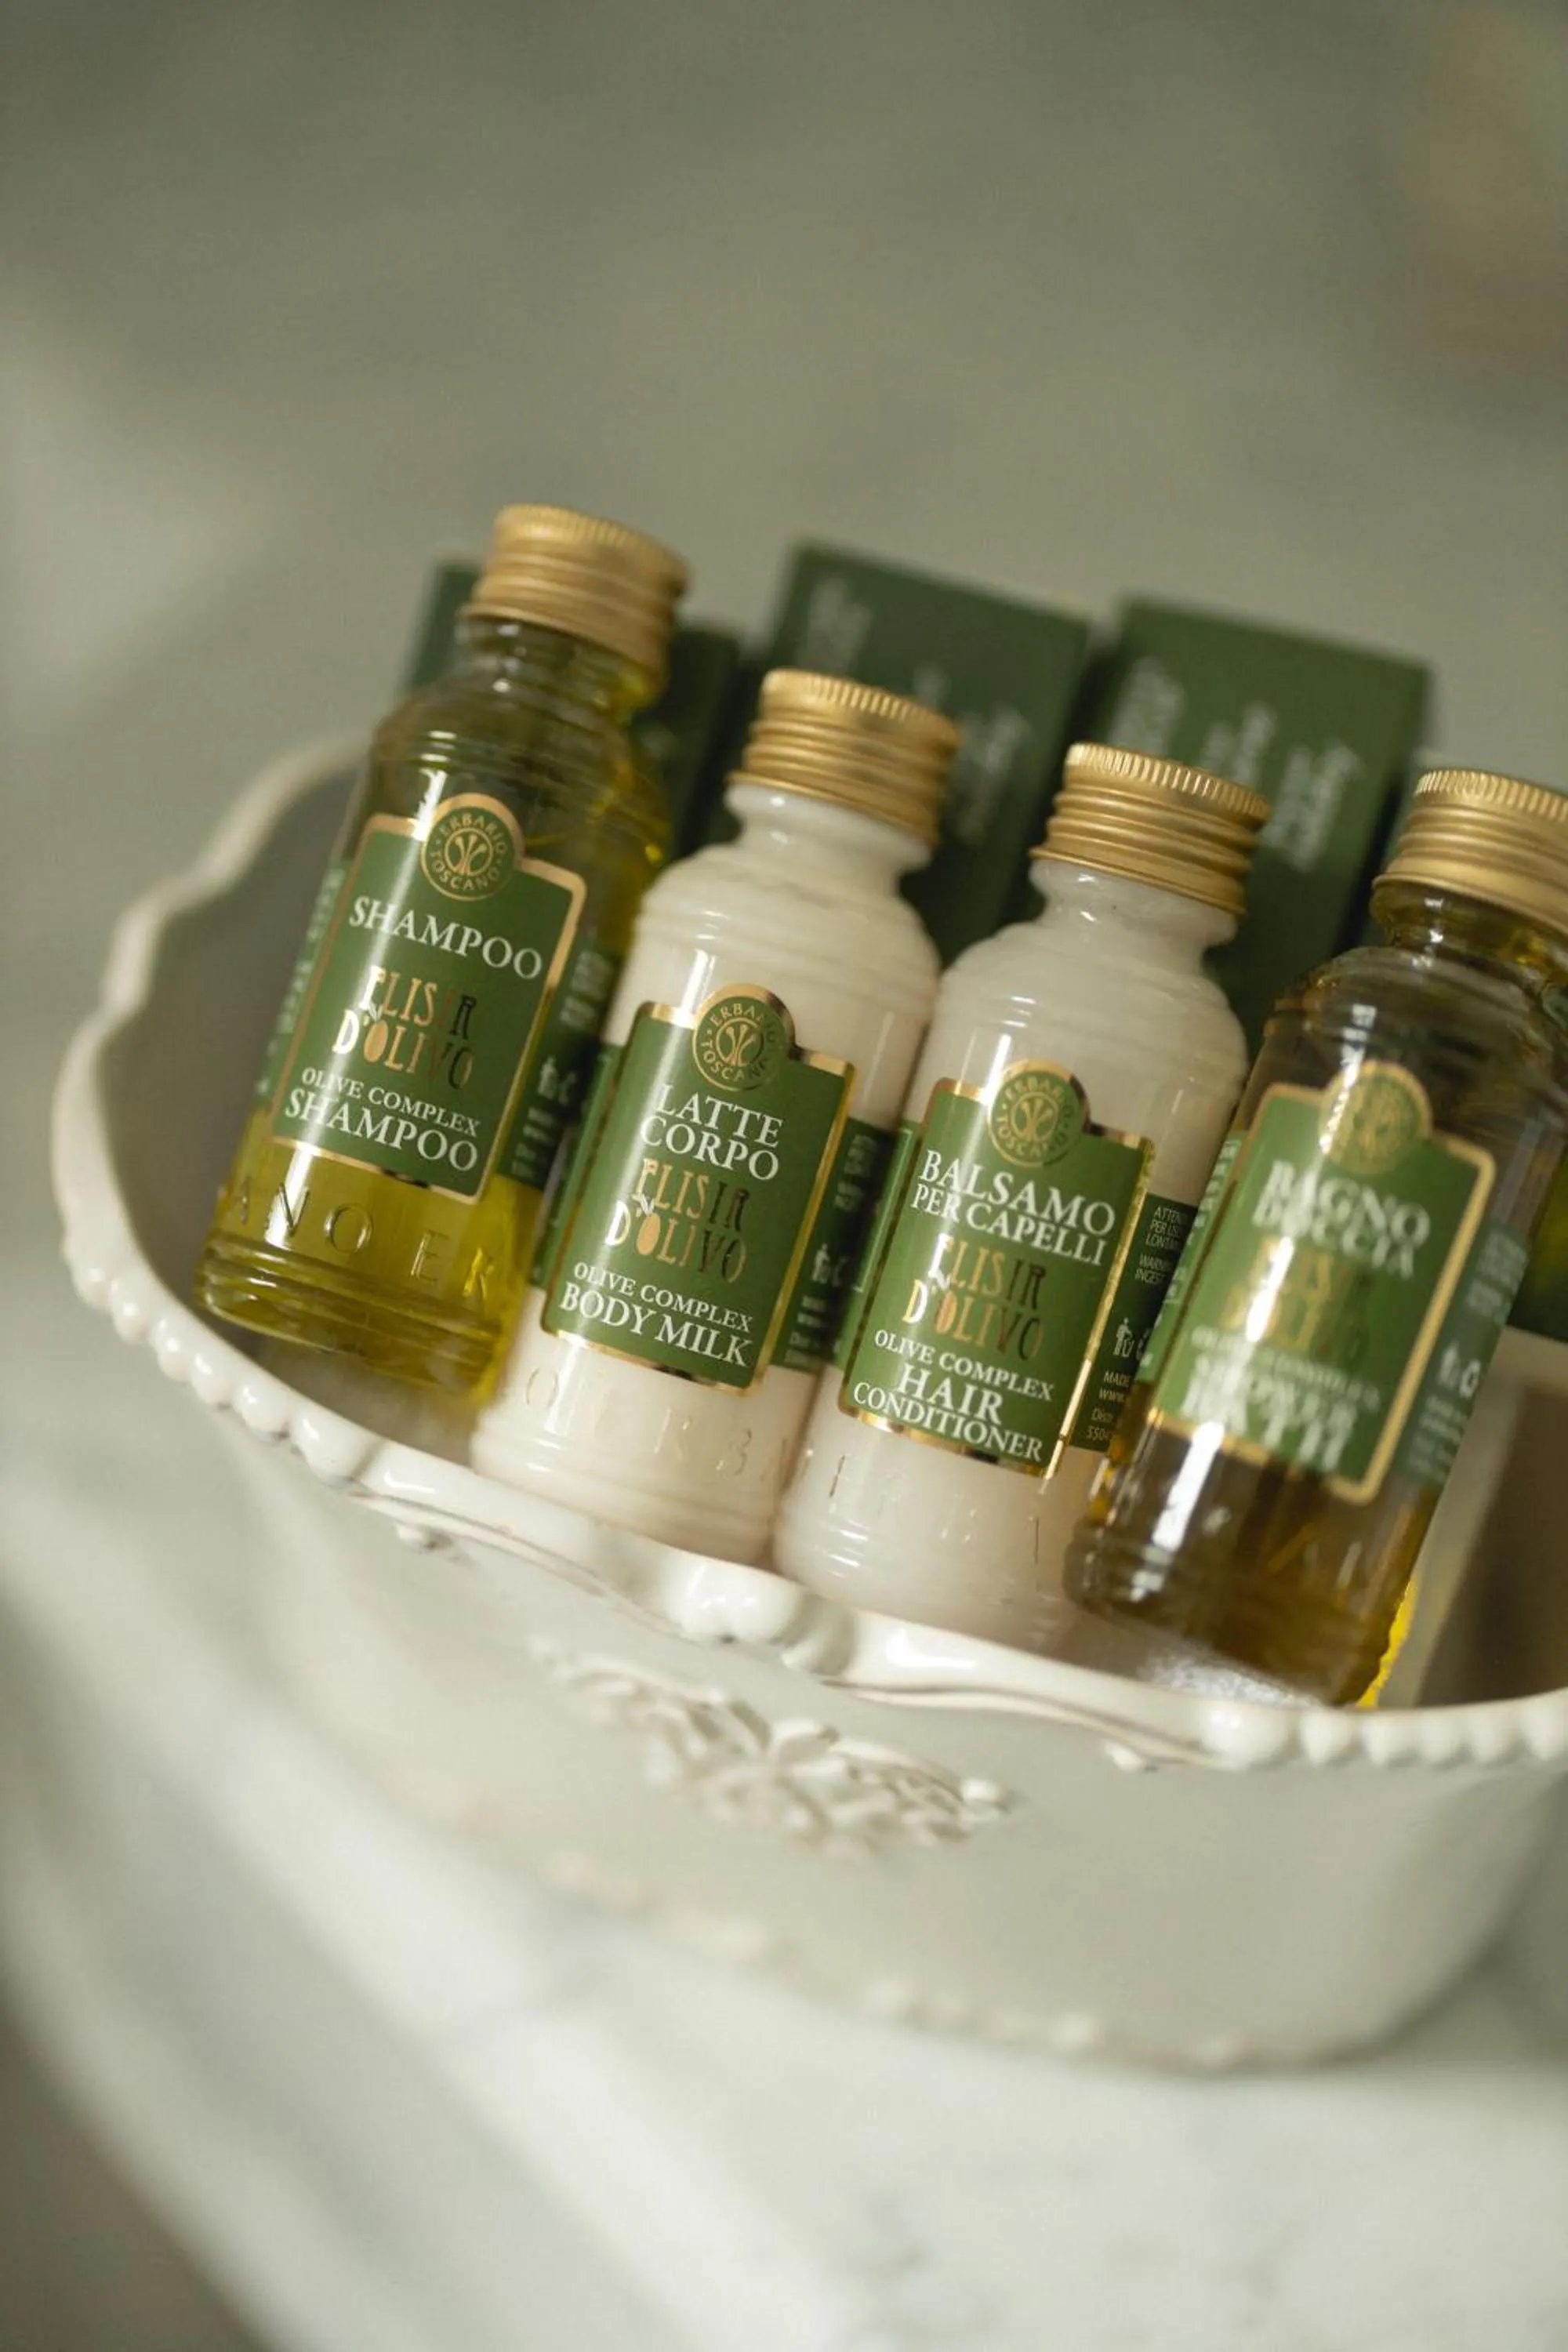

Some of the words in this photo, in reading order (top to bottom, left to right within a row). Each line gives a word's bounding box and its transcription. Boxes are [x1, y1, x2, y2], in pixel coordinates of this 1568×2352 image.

[349, 895, 543, 981] SHAMPOO
[285, 1089, 479, 1173] SHAMPOO
[302, 1067, 365, 1100] OLIVE
[368, 1086, 481, 1138] COMPLEX
[654, 1083, 784, 1149] LATTE
[640, 1116, 779, 1181] CORPO
[910, 1185, 960, 1225] PER
[967, 1201, 1109, 1267] CAPELLI
[920, 1149, 1116, 1236] BALSAMO
[559, 1282, 655, 1339] BODY
[655, 1319, 753, 1367] MILK
[573, 1261, 635, 1296] OLIVE
[640, 1283, 753, 1334] COMPLEX
[874, 1329, 935, 1366] OLIVE
[938, 1352, 1054, 1402] COMPLEX
[895, 1362, 1006, 1425] HAIR
[853, 1381, 1044, 1462] CONDITIONER
